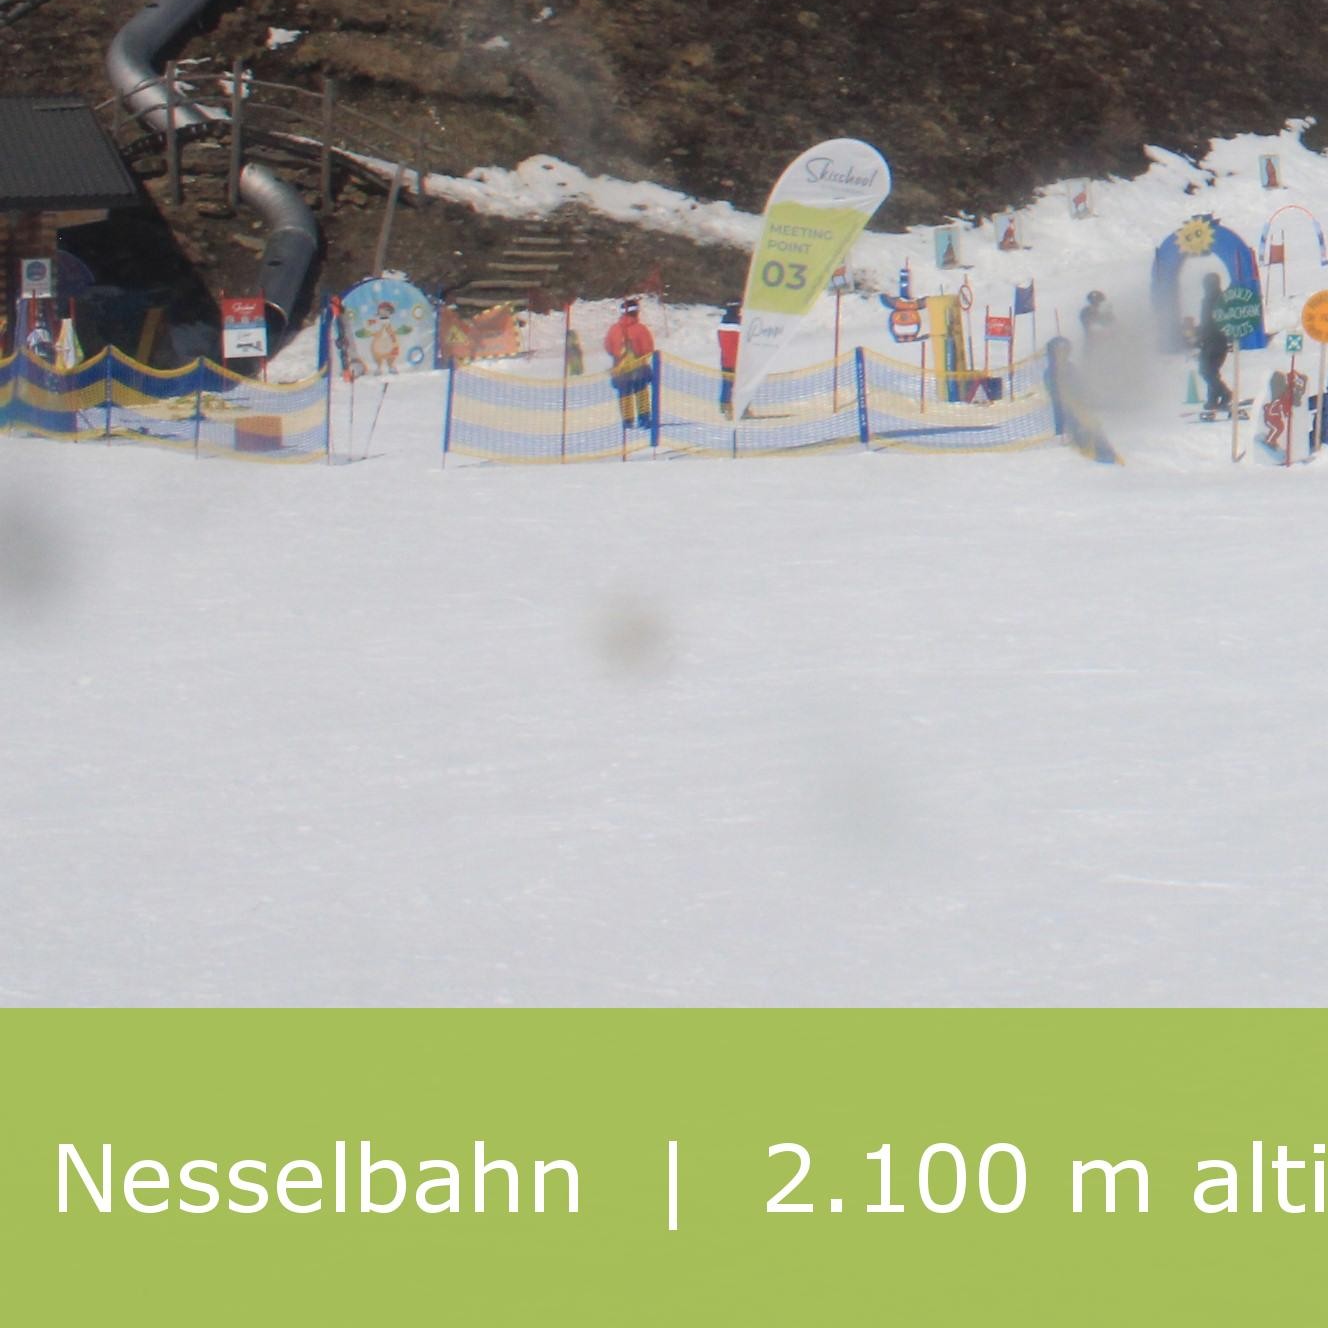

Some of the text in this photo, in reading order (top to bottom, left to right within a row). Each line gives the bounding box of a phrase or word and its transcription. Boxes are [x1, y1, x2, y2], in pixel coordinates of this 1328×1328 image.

[806, 157, 878, 188] Skischool
[769, 223, 833, 241] MEETING
[767, 239, 813, 254] POINT
[762, 260, 807, 290] 03
